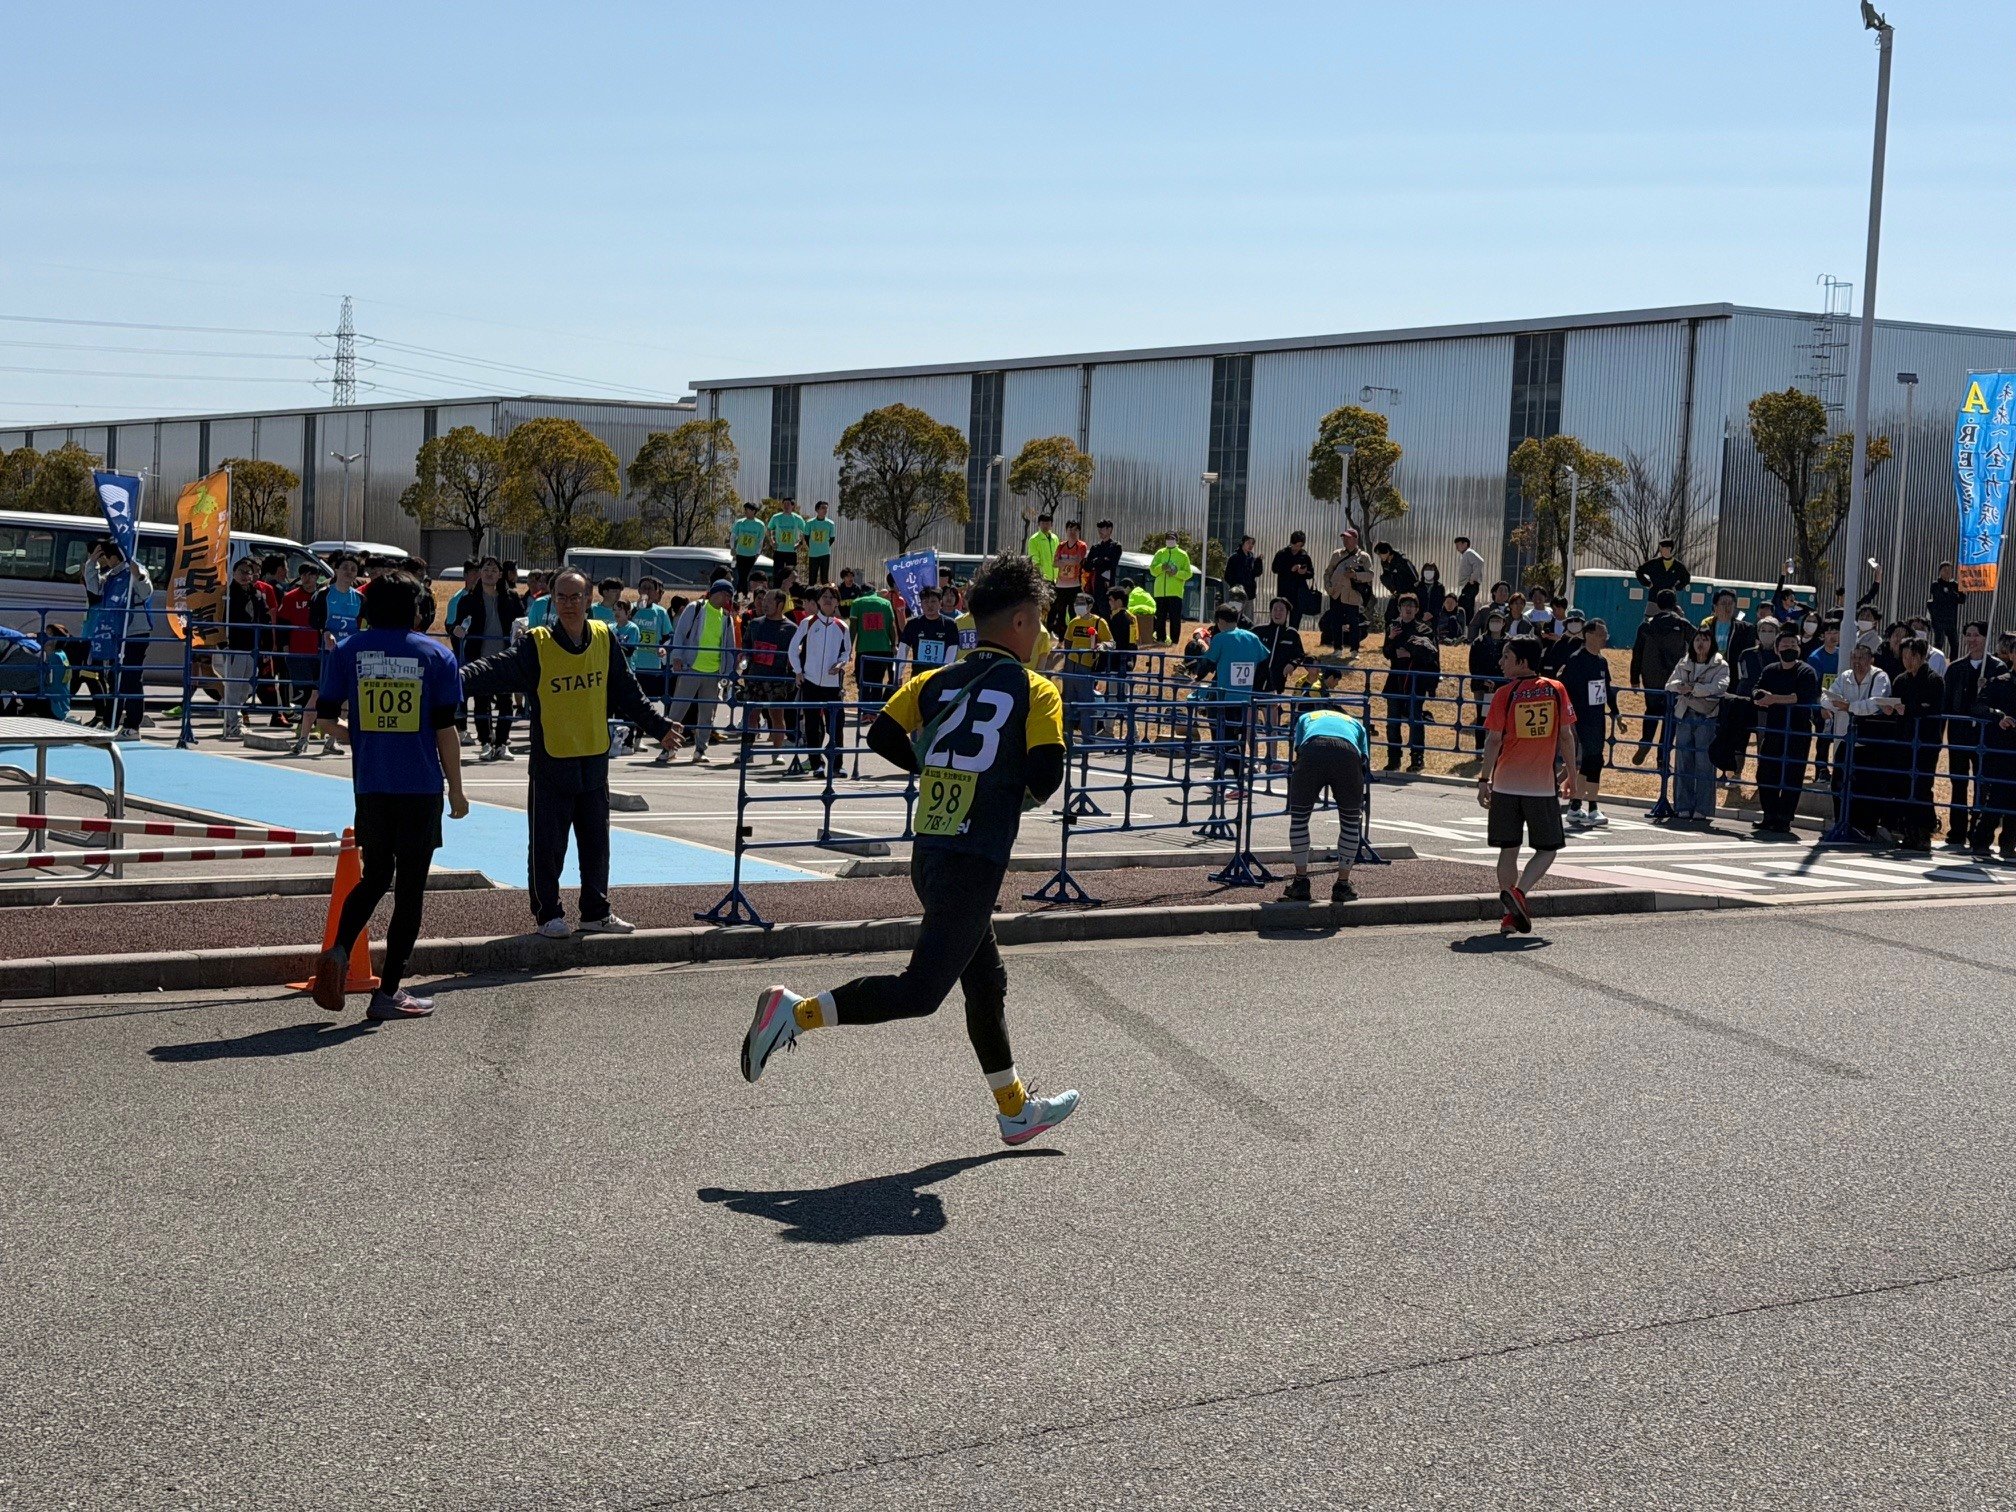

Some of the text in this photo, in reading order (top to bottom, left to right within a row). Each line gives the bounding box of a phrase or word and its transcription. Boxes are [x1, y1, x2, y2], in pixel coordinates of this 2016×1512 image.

[962, 632, 976, 643] 18
[924, 645, 939, 655] 81
[550, 670, 603, 693] STAFF
[1236, 666, 1251, 677] 70
[365, 689, 413, 714] 108
[1524, 707, 1549, 727] 25
[924, 688, 1015, 773] 23
[928, 780, 962, 814] 98
